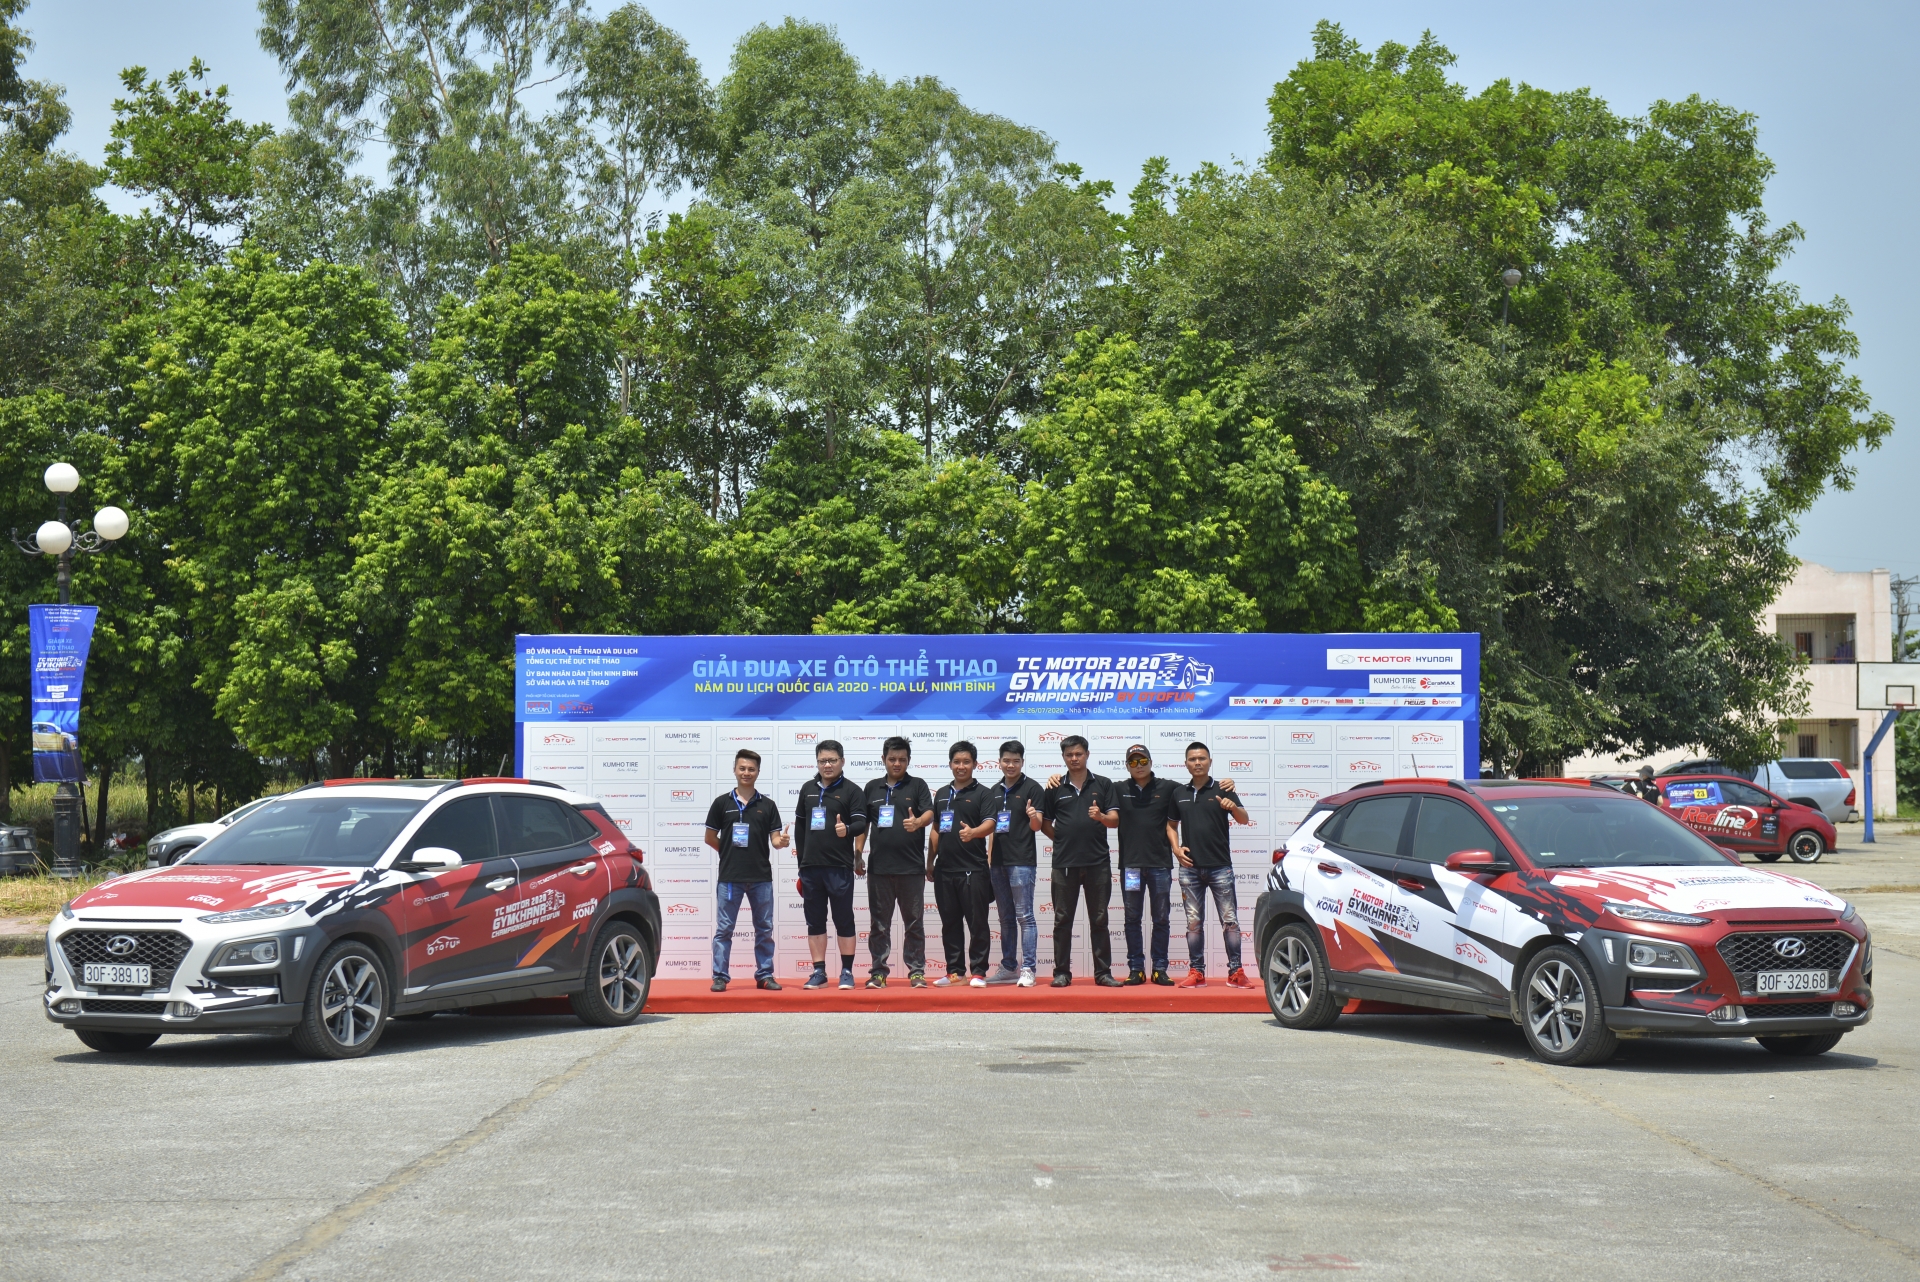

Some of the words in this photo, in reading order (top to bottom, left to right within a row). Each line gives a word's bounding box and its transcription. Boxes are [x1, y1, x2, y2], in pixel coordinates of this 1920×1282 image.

[692, 654, 737, 677] GIẢI
[744, 660, 791, 677] ĐUA
[798, 660, 826, 677] XE
[834, 655, 879, 677] ÔTÔ
[886, 649, 929, 677] THỂ
[936, 659, 997, 677] THAO
[1017, 657, 1042, 670] TC
[1045, 657, 1112, 670] MOTOR
[1116, 657, 1160, 670] 2020
[695, 680, 723, 692] NĂM
[727, 682, 743, 692] DU
[747, 682, 773, 694] LỊCH
[777, 678, 810, 692] QUỐC
[814, 682, 834, 692] GIA
[838, 682, 869, 692] 2020
[880, 682, 906, 692] HOA
[932, 682, 962, 692] NINH
[966, 679, 995, 692] BÌNH
[1009, 672, 1157, 690] GYMKHANA
[1006, 692, 1114, 702] CHAMPIONSHIP
[1116, 692, 1136, 702] BY
[1138, 692, 1195, 702] OTOFUN
[543, 874, 557, 883] MOTOR
[1357, 870, 1371, 880] MOTOR
[433, 892, 449, 901] MOTOR
[1352, 889, 1361, 898] TC
[1361, 892, 1384, 908] MOTOR
[1384, 902, 1400, 914] 2020
[495, 907, 504, 917] TC
[506, 899, 530, 913] MOTOR
[531, 893, 546, 906] 2020
[573, 905, 594, 920] KONA
[1316, 900, 1338, 914] KONA
[1348, 897, 1399, 926] GYMKHANA
[1479, 902, 1498, 915] MOTOR
[491, 920, 532, 938] CHAMPIONSHIP
[532, 917, 539, 926] BY
[540, 911, 560, 922] OTOFUN
[493, 903, 546, 930] GYMKHANA
[1346, 908, 1383, 927] CHAMPIONSHIP
[1391, 925, 1412, 939] OTOFUN
